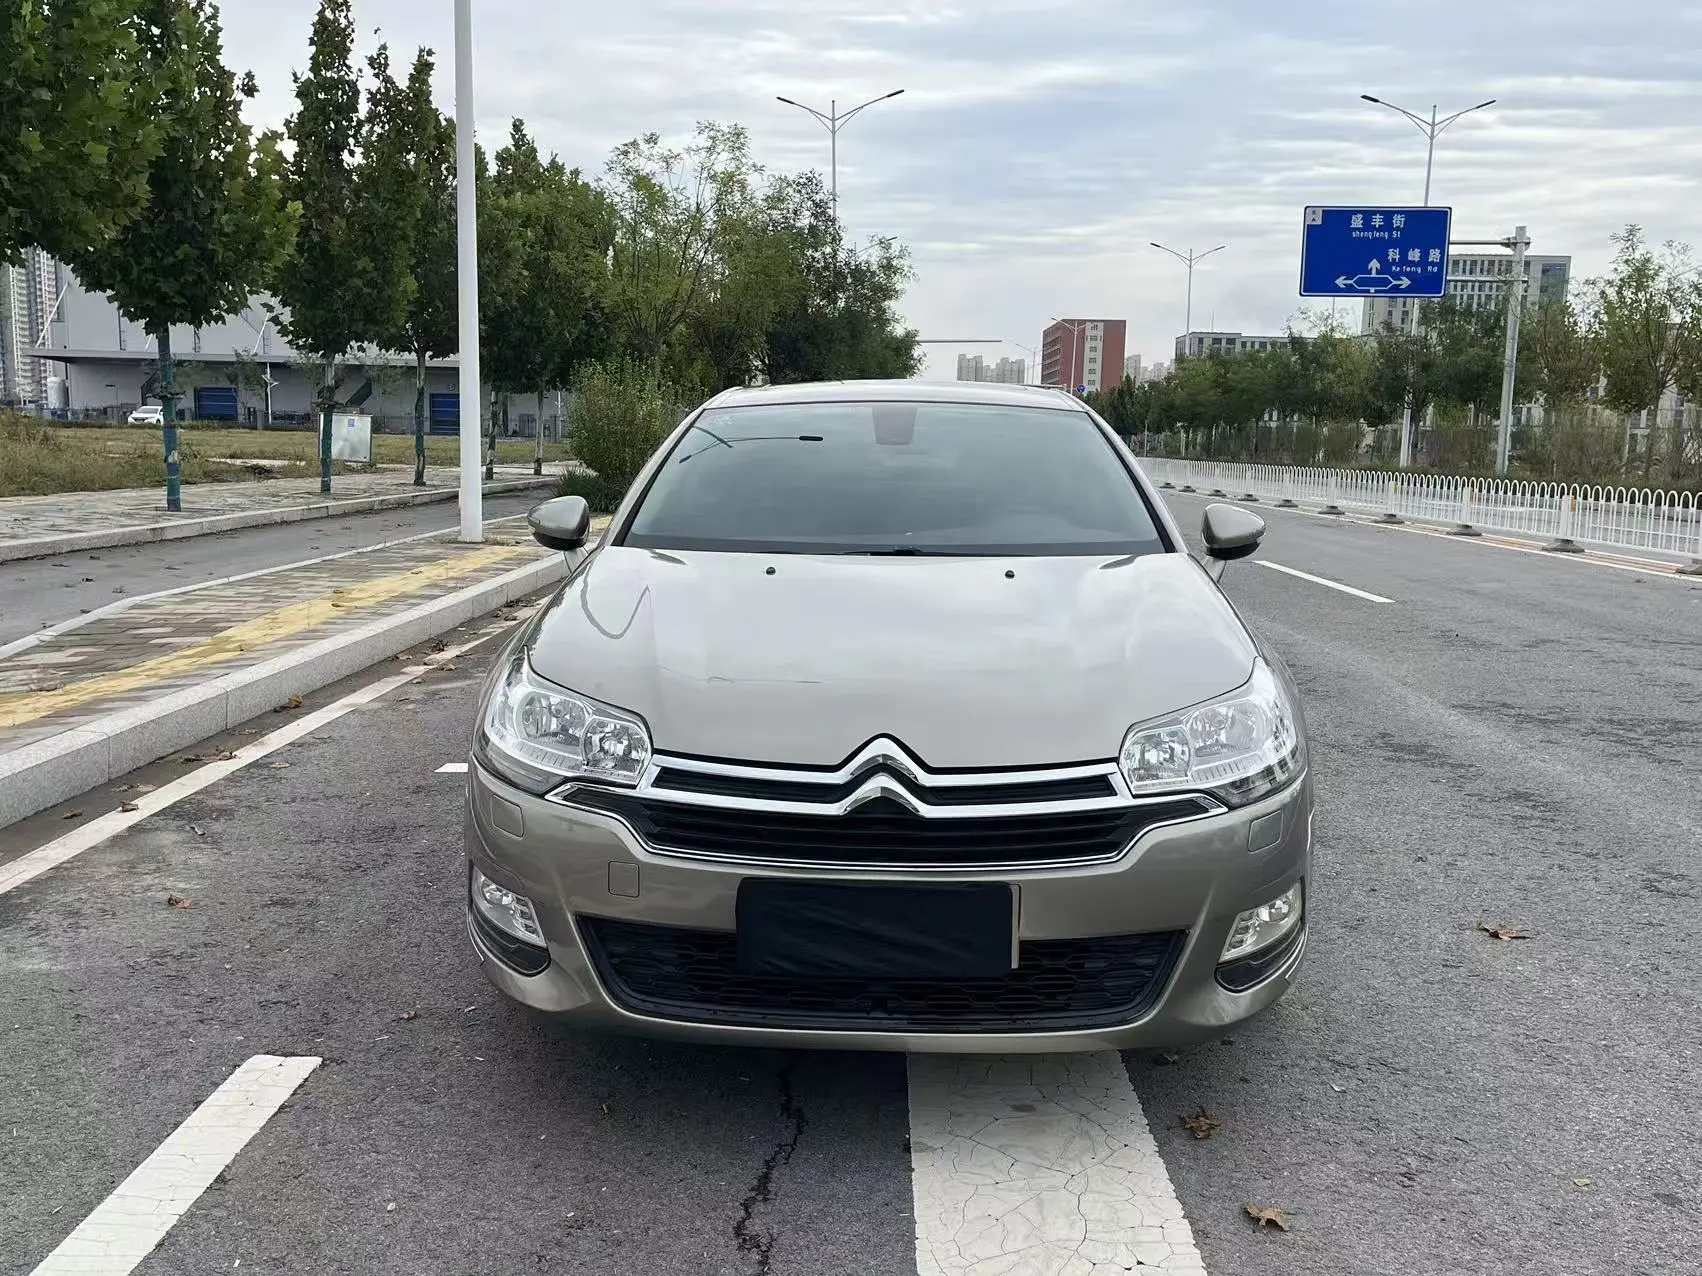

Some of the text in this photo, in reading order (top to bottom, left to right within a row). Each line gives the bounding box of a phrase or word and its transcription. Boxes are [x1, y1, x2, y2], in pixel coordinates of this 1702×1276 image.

[1350, 213, 1406, 228] 盛丰街
[1387, 248, 1441, 262] 科峰路
